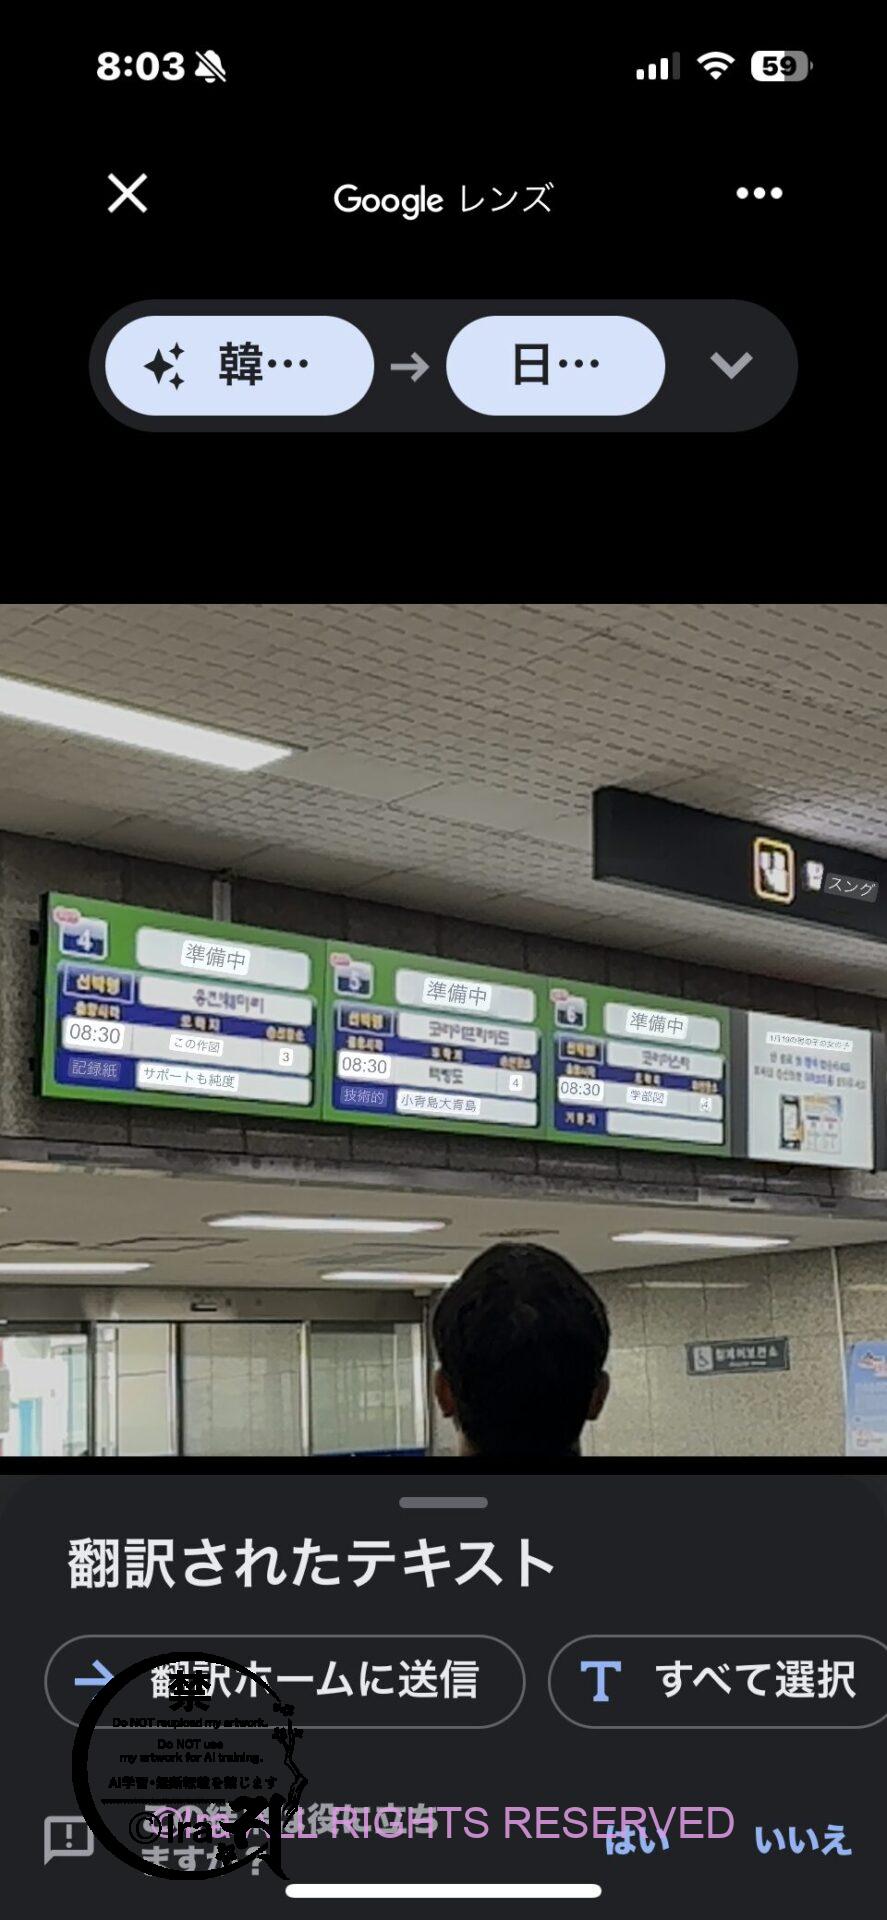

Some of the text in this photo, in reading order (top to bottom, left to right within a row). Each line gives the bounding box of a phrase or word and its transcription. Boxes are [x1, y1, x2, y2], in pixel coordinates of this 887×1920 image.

[96, 51, 186, 81] 8:03
[762, 55, 797, 76] 59
[333, 181, 555, 220] Google レンズ
[67, 1537, 554, 1590] 翻訳されたテキスト
[655, 1659, 857, 1699] すべて選択
[143, 1802, 439, 1834] この結は役に立ち
[606, 1824, 670, 1856] はい
[755, 1824, 853, 1856] いいえ
